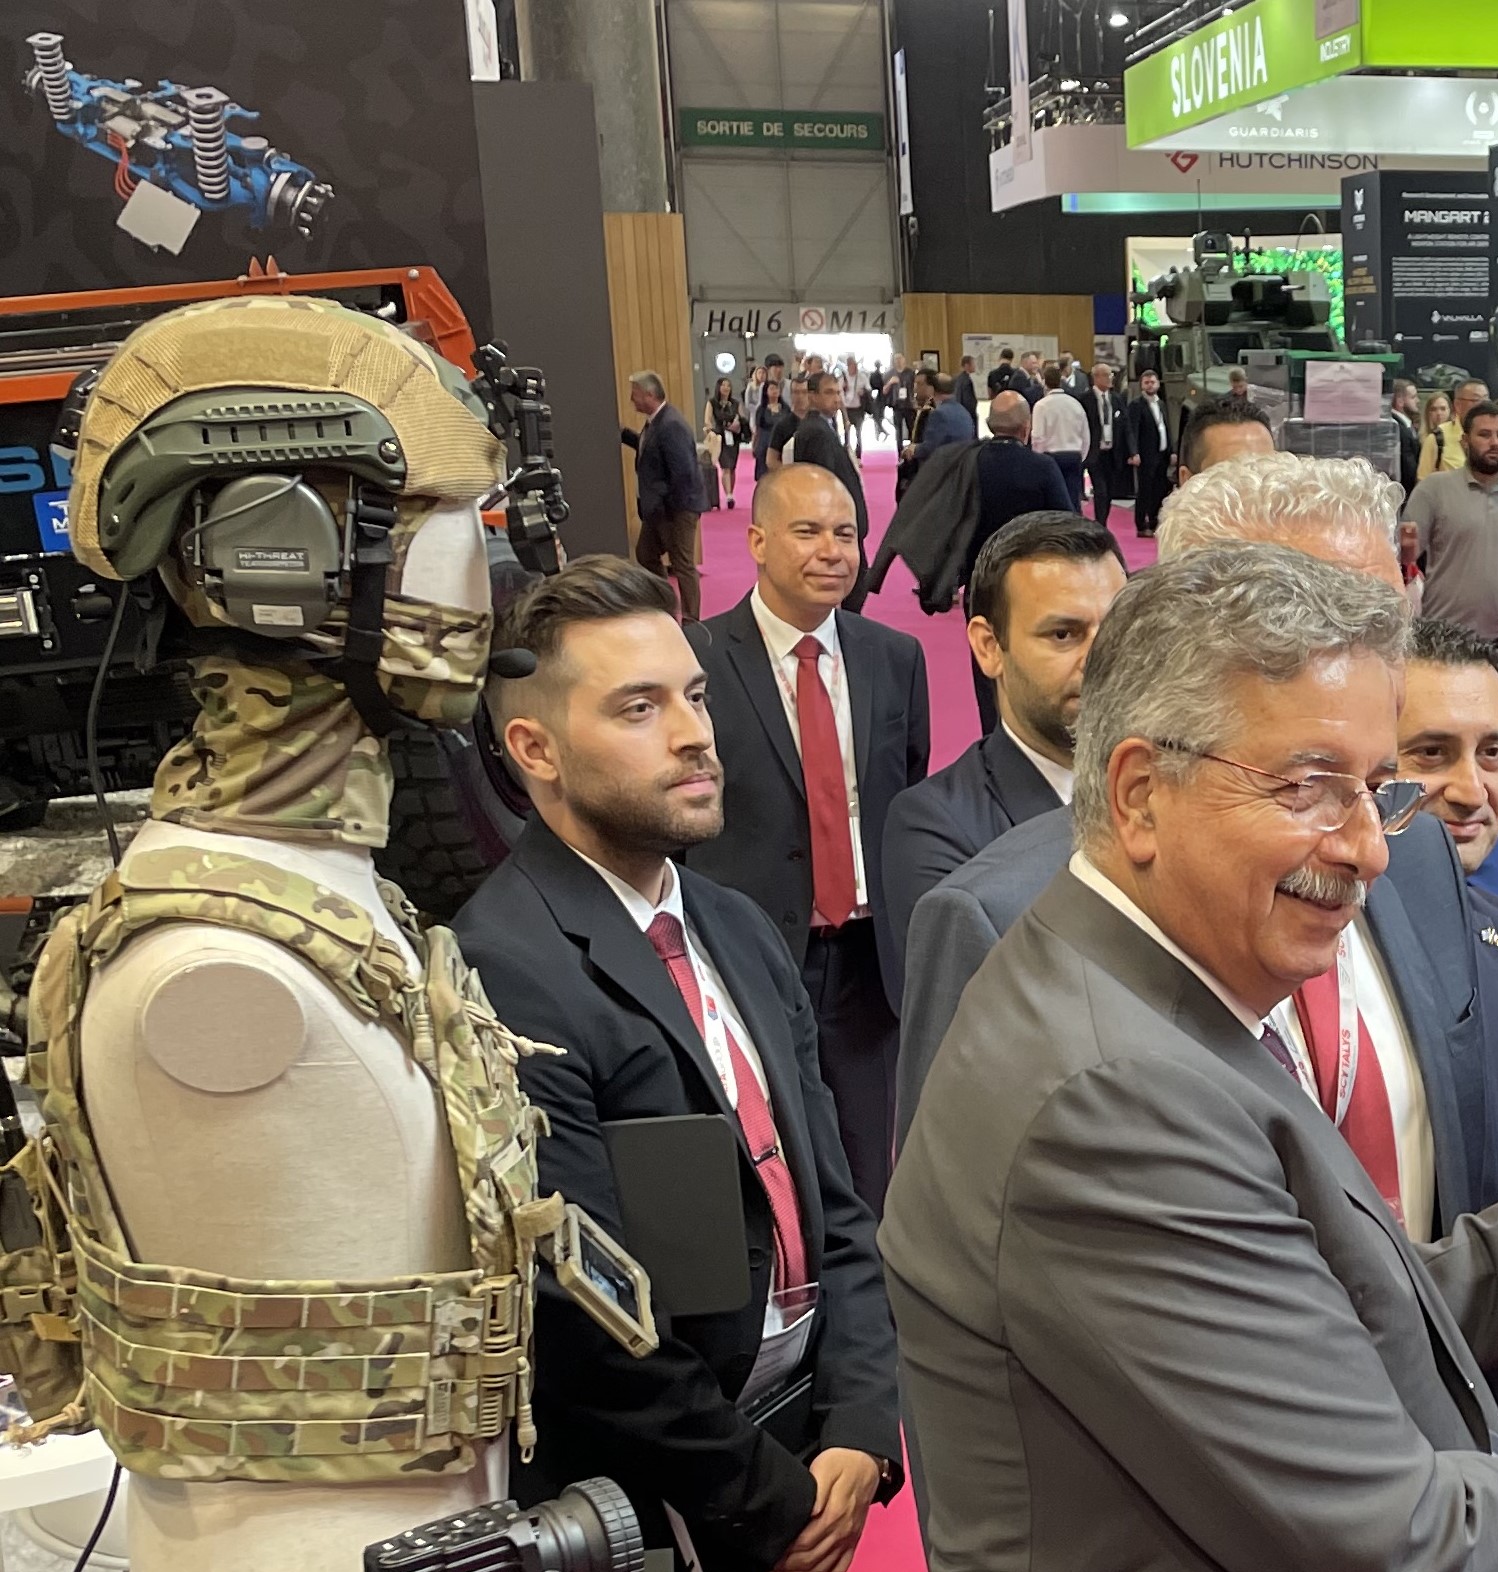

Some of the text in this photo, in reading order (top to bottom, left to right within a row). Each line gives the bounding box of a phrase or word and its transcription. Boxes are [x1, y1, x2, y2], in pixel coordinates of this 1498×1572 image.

[1170, 15, 1268, 118] SLOVENIA
[697, 120, 868, 138] SORTIE DE SECOURS
[1228, 127, 1319, 138] GUARDIARIS
[1219, 153, 1378, 170] HUTCHINSON
[1404, 210, 1481, 223] MANGART
[707, 309, 888, 333] Hall 6 M14
[1338, 1028, 1351, 1099] SCYTALYS
